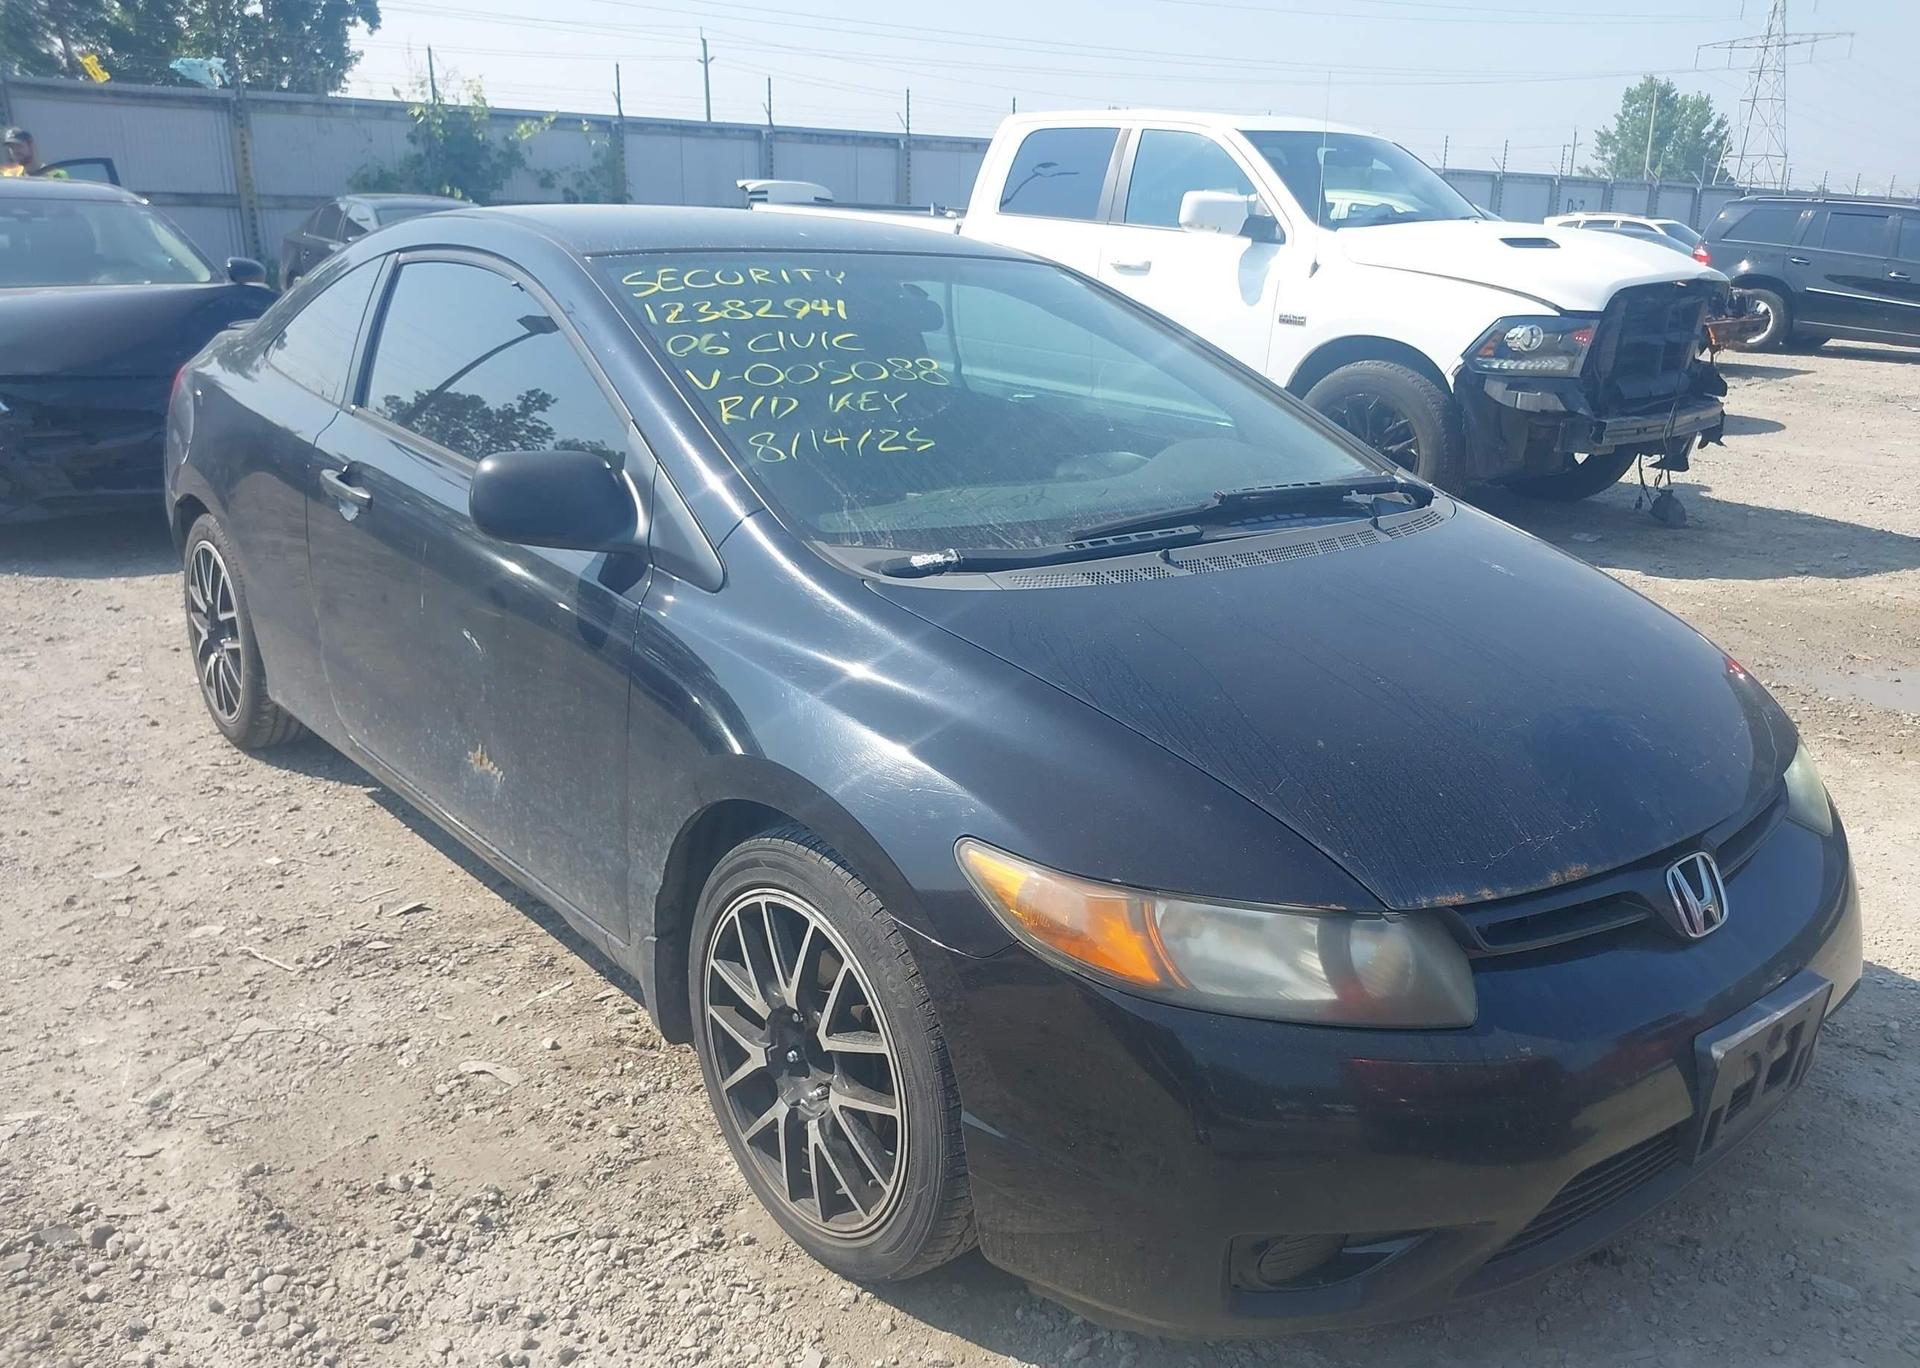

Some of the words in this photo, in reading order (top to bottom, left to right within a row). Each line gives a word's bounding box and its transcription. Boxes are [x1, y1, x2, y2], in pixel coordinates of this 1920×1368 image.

[622, 268, 846, 297] SECURITY
[645, 299, 848, 325] 12382941
[747, 331, 866, 353] CIVIC
[829, 391, 908, 421] KEY
[749, 428, 936, 463] 8/14/25
[1669, 853, 1726, 937] H
